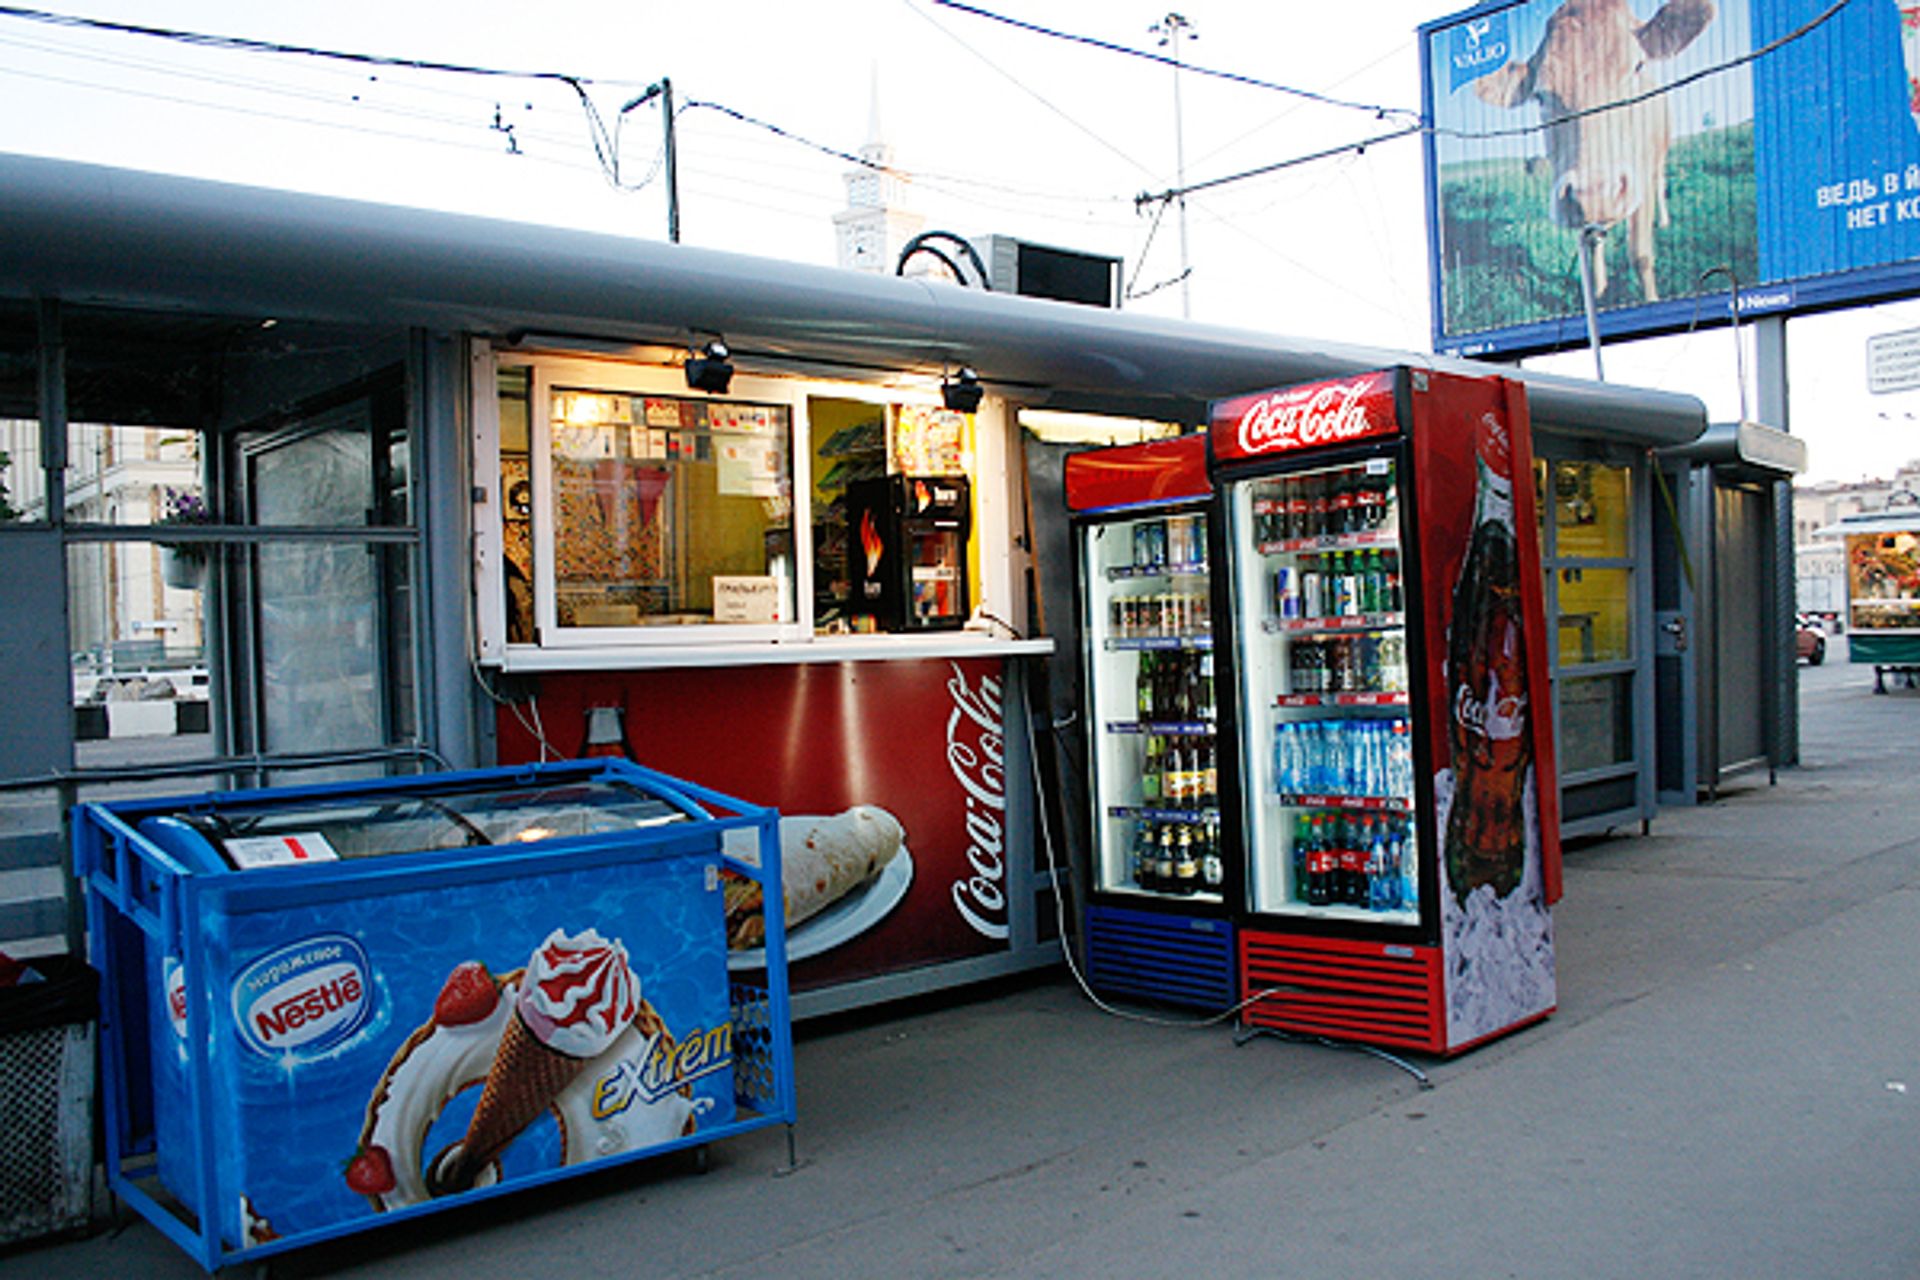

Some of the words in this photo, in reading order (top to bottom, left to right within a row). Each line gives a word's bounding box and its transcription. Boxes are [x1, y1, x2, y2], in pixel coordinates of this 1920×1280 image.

[1817, 179, 1877, 208] ВЕДЬ
[1884, 172, 1899, 195] В
[1847, 202, 1889, 230] НЕТ
[1238, 381, 1374, 453] Coca-Cola
[947, 660, 1009, 939] Coca-Cola
